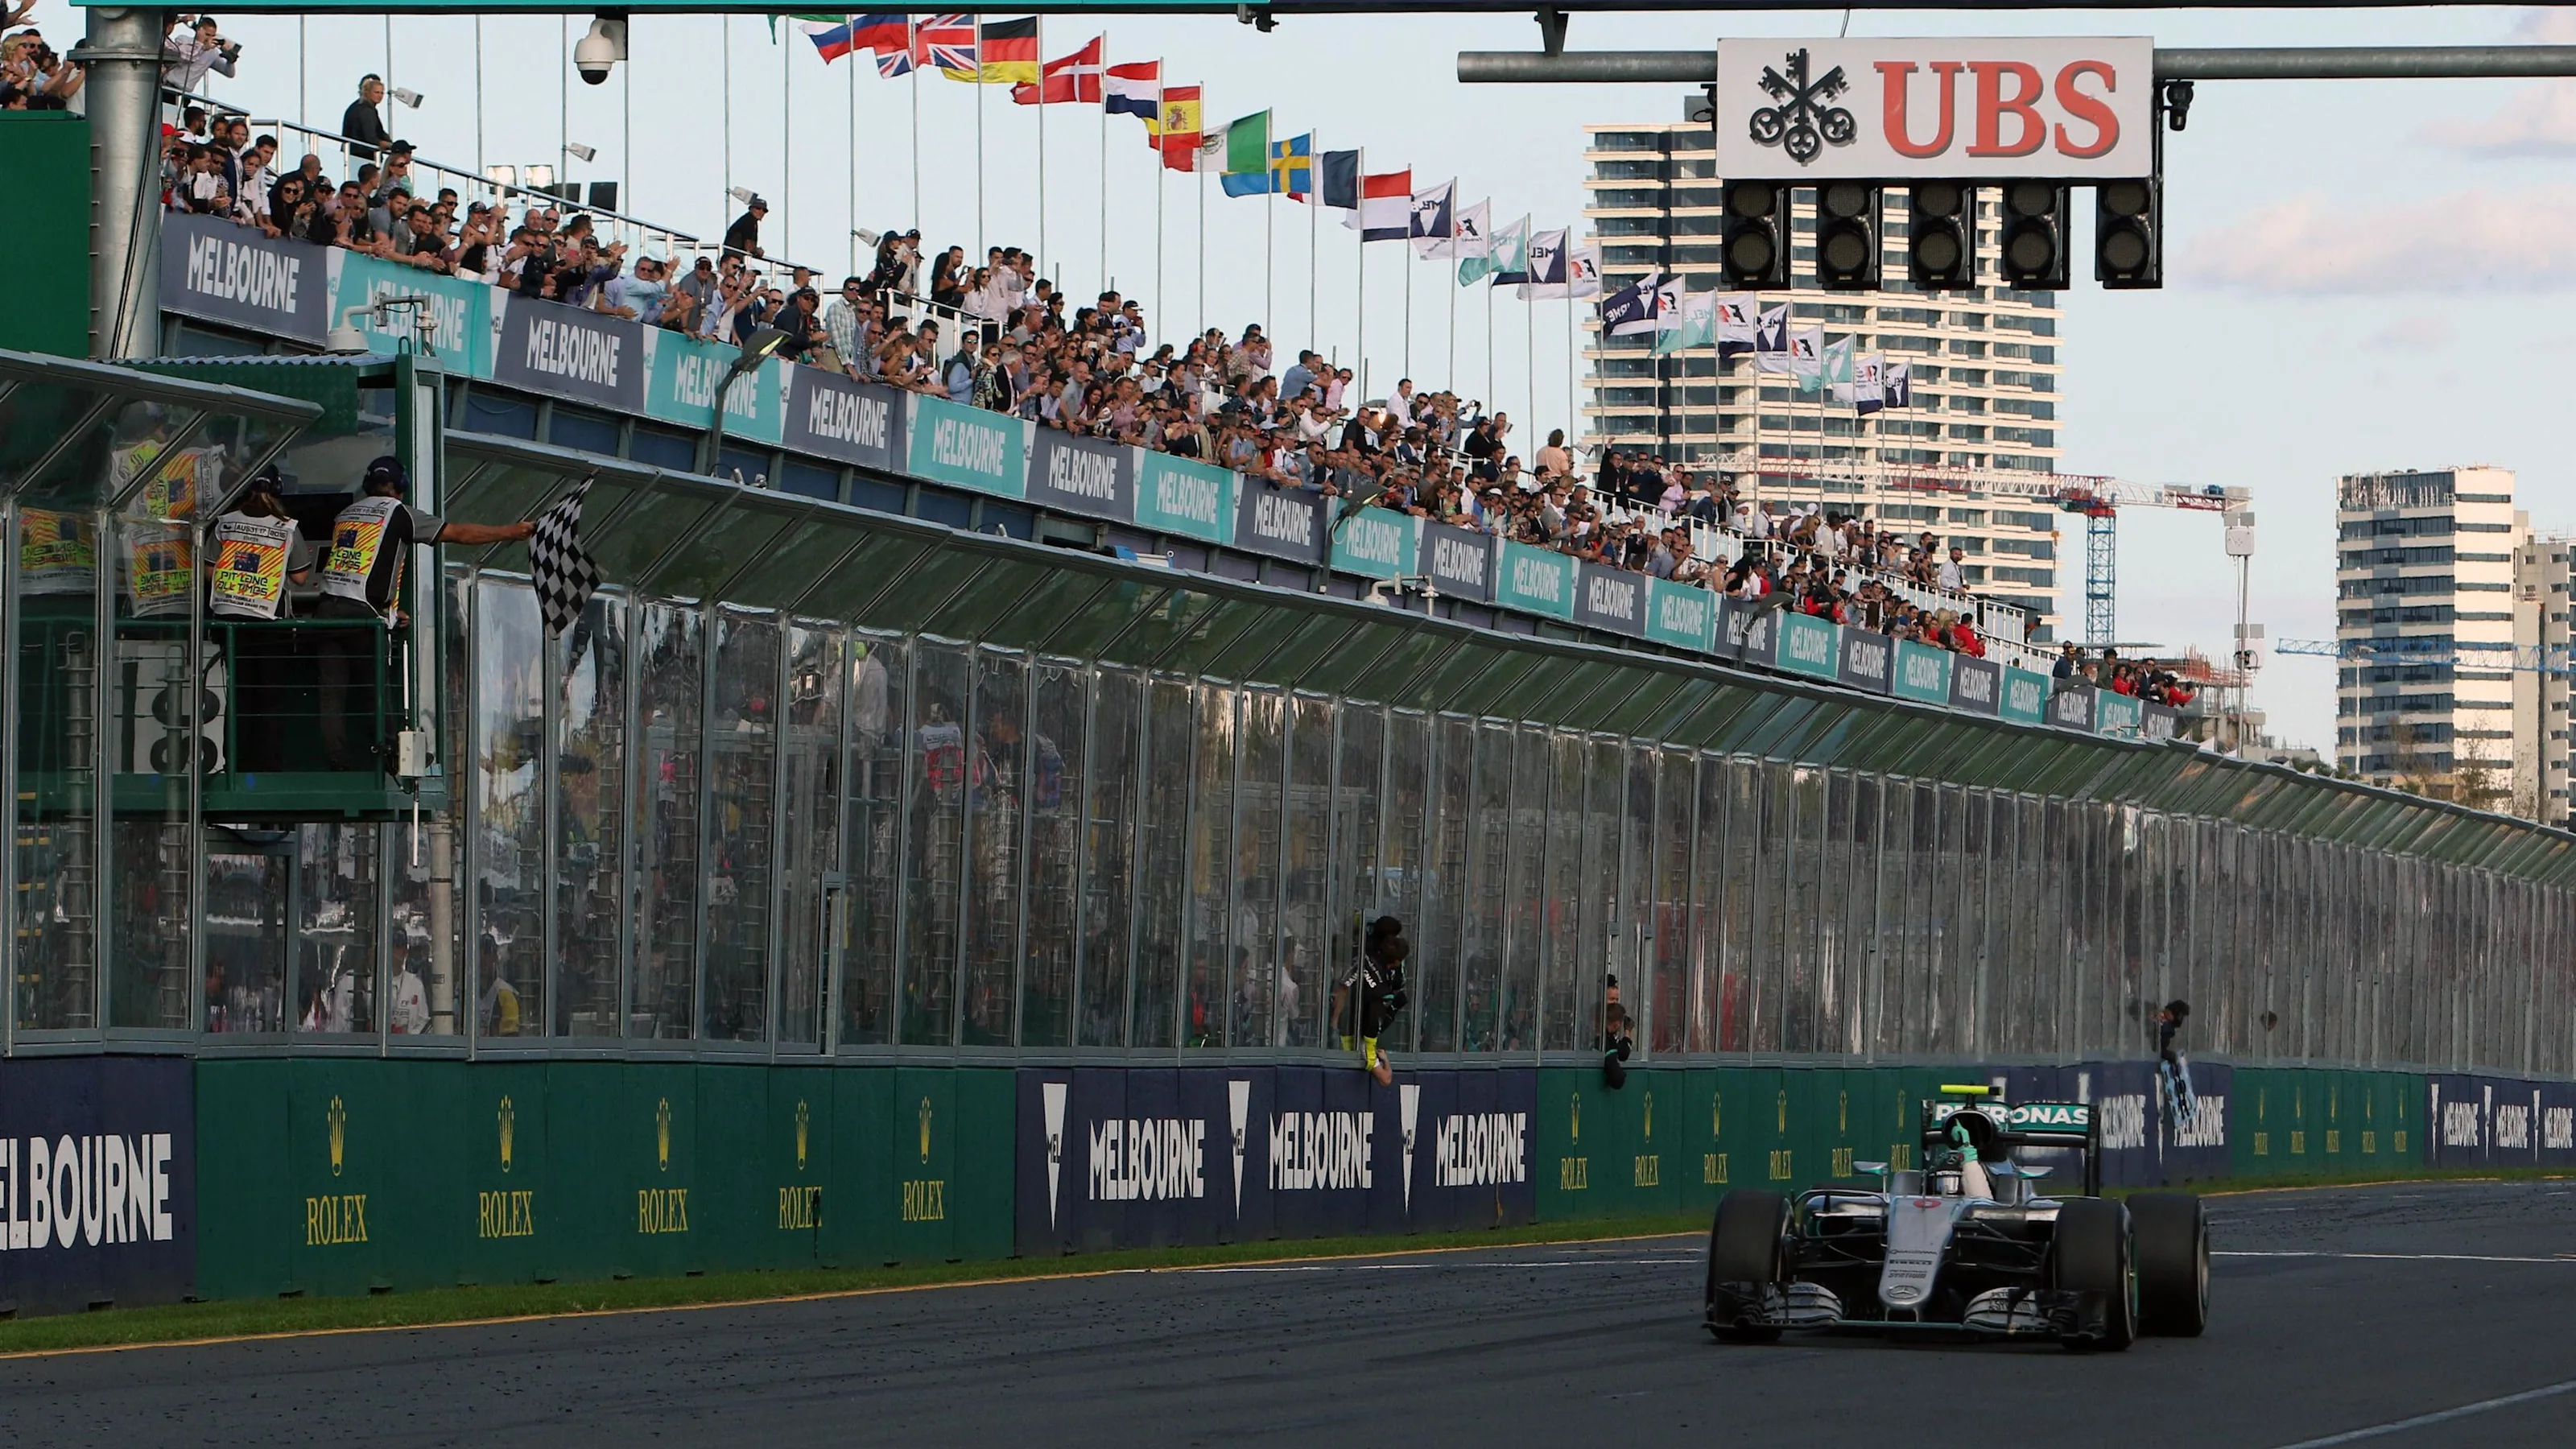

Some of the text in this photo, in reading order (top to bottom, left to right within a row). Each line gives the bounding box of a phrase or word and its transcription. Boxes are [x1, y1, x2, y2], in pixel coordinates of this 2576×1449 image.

[1873, 60, 2120, 159] UBS
[188, 231, 300, 314] MELBOURNE
[365, 275, 465, 352] MELBORNE
[526, 316, 621, 388] MELBOURNE
[809, 385, 888, 449] MELBOURNE
[932, 415, 1005, 477] MELBOURNE
[1048, 442, 1117, 500] MELBOURNE
[1156, 470, 1218, 523] MELBOURNE
[1254, 493, 1313, 547] MELBOURNE
[1346, 517, 1402, 567] MELBOURNE
[1433, 536, 1484, 586] MELBOURNE
[221, 571, 238, 580] PIT
[1513, 556, 1561, 602] MELBOURNE
[1588, 576, 1635, 620] MELBOURNE
[1660, 594, 1704, 637] MELBOURNE
[1935, 1104, 2089, 1125] PRONAS
[1089, 1117, 1204, 1201] MELBOURNE
[1269, 1112, 1373, 1191] MELBOURNE
[1435, 1112, 1526, 1187] MELBOURNE
[1560, 1157, 1587, 1191] ROLEX
[1634, 1154, 1658, 1187] ROLEX
[1704, 1153, 1728, 1184] ROLEX
[1770, 1149, 1792, 1180] ROLEX
[306, 1195, 368, 1245] ROLEX
[479, 1190, 535, 1238] ROLEX
[638, 1189, 688, 1234] ROLEX
[902, 1180, 944, 1221] ROLEX
